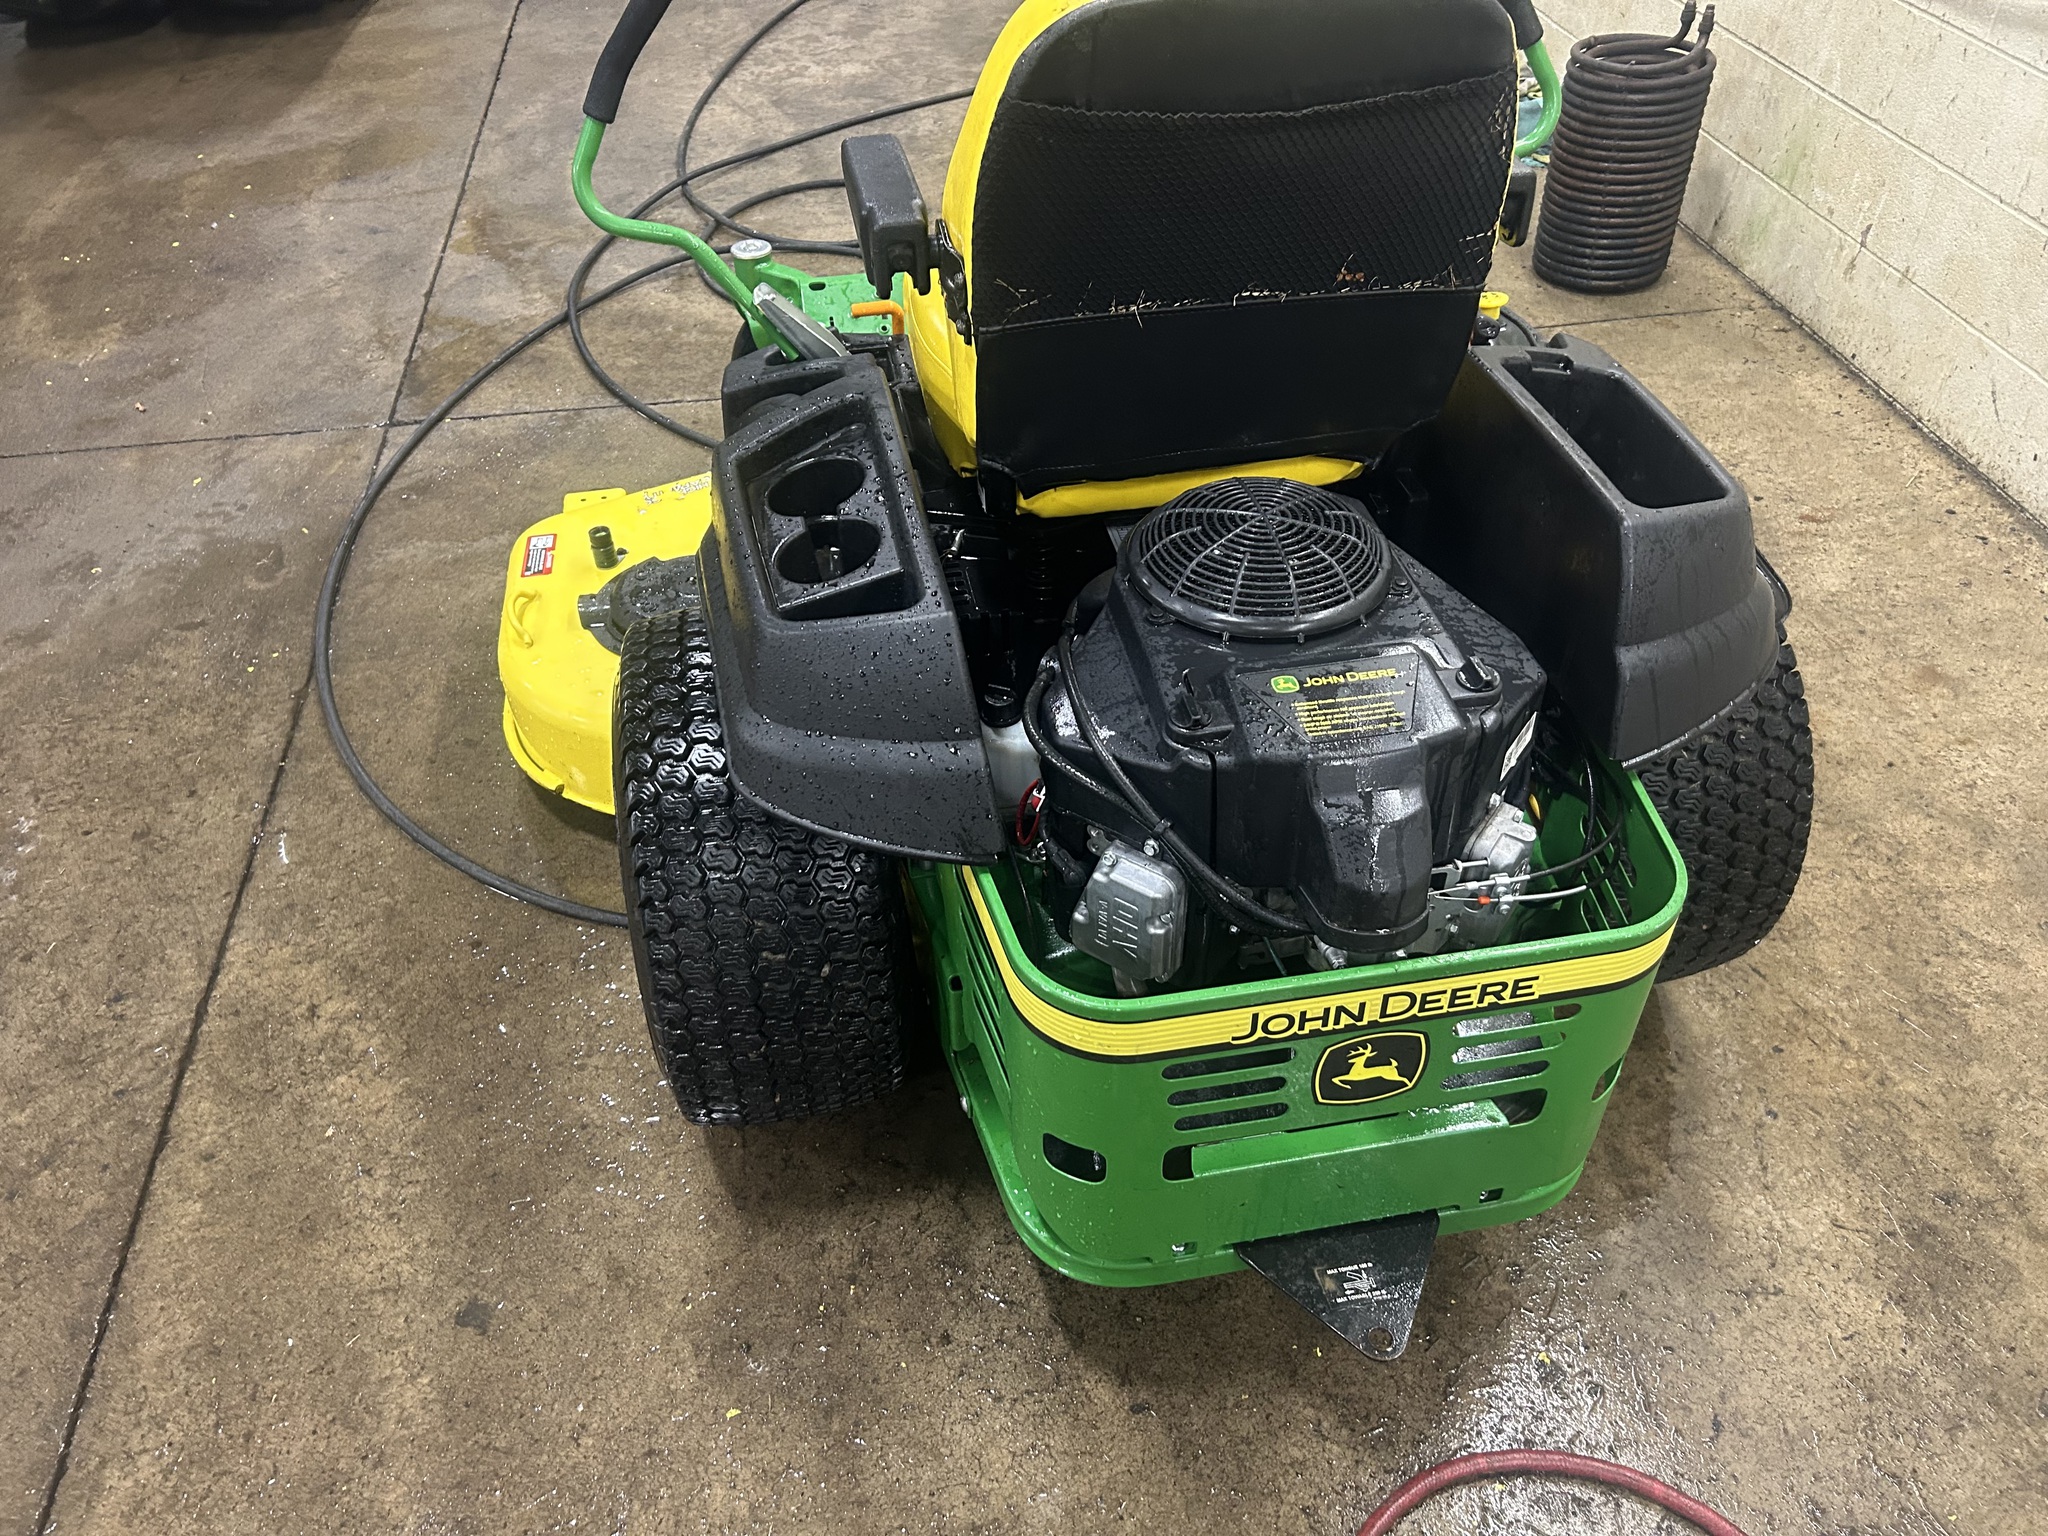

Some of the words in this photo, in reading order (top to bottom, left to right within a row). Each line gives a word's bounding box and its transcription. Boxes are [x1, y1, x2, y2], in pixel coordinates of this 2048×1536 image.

[1303, 673, 1345, 688] JOHN
[1345, 668, 1397, 683] DEERE
[1231, 1001, 1367, 1043] JOHN
[1378, 976, 1541, 1021] DEERE
